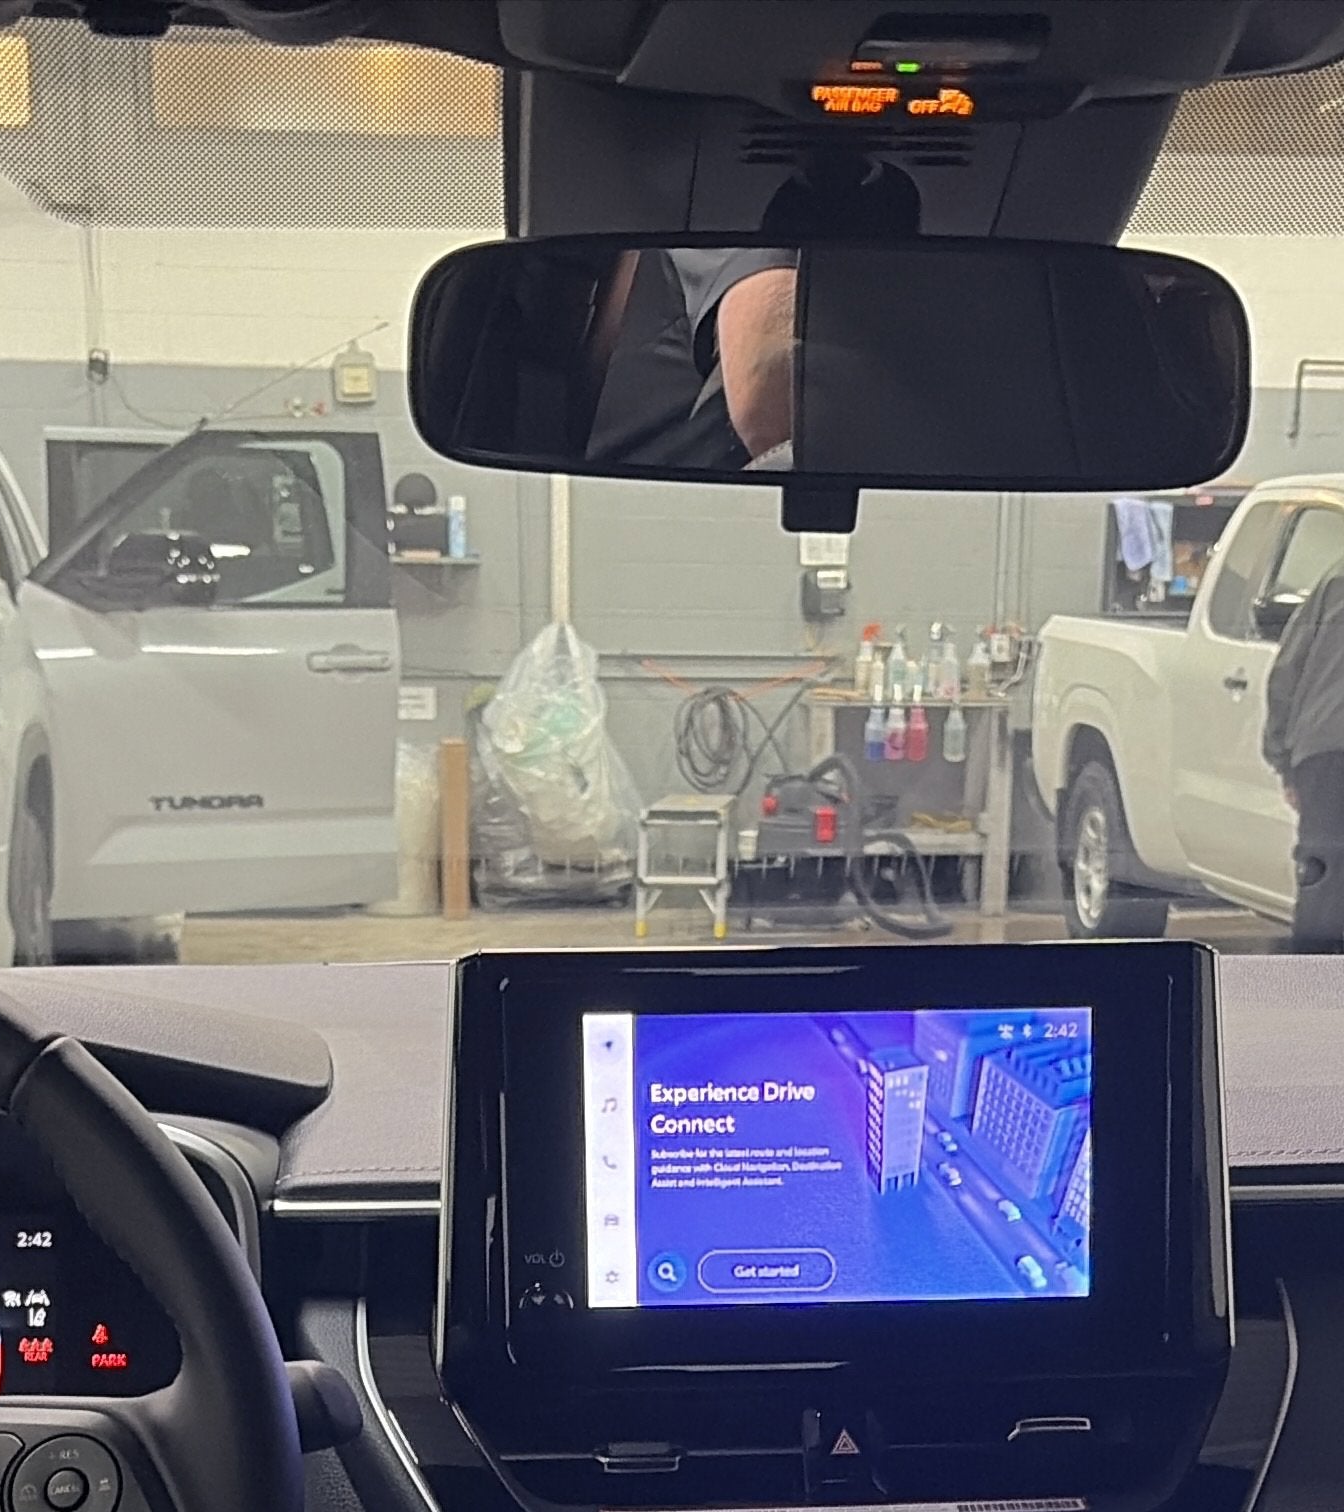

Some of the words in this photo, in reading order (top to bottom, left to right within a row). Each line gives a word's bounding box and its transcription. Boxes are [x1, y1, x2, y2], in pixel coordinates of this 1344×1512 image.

[812, 85, 899, 101] PASSENGER
[824, 100, 849, 112] AIR
[851, 100, 883, 112] BAG
[908, 99, 940, 115] OFF
[148, 794, 264, 811] TUNDRA
[1044, 1022, 1078, 1038] 2:42
[650, 1082, 759, 1107] Experience
[763, 1081, 816, 1102] Drive
[650, 1113, 736, 1134] Connect
[17, 1231, 53, 1248] 2:42
[733, 1265, 757, 1278] Get
[757, 1263, 800, 1278] started
[24, 1352, 48, 1363] REAR
[91, 1353, 127, 1368] PARK
